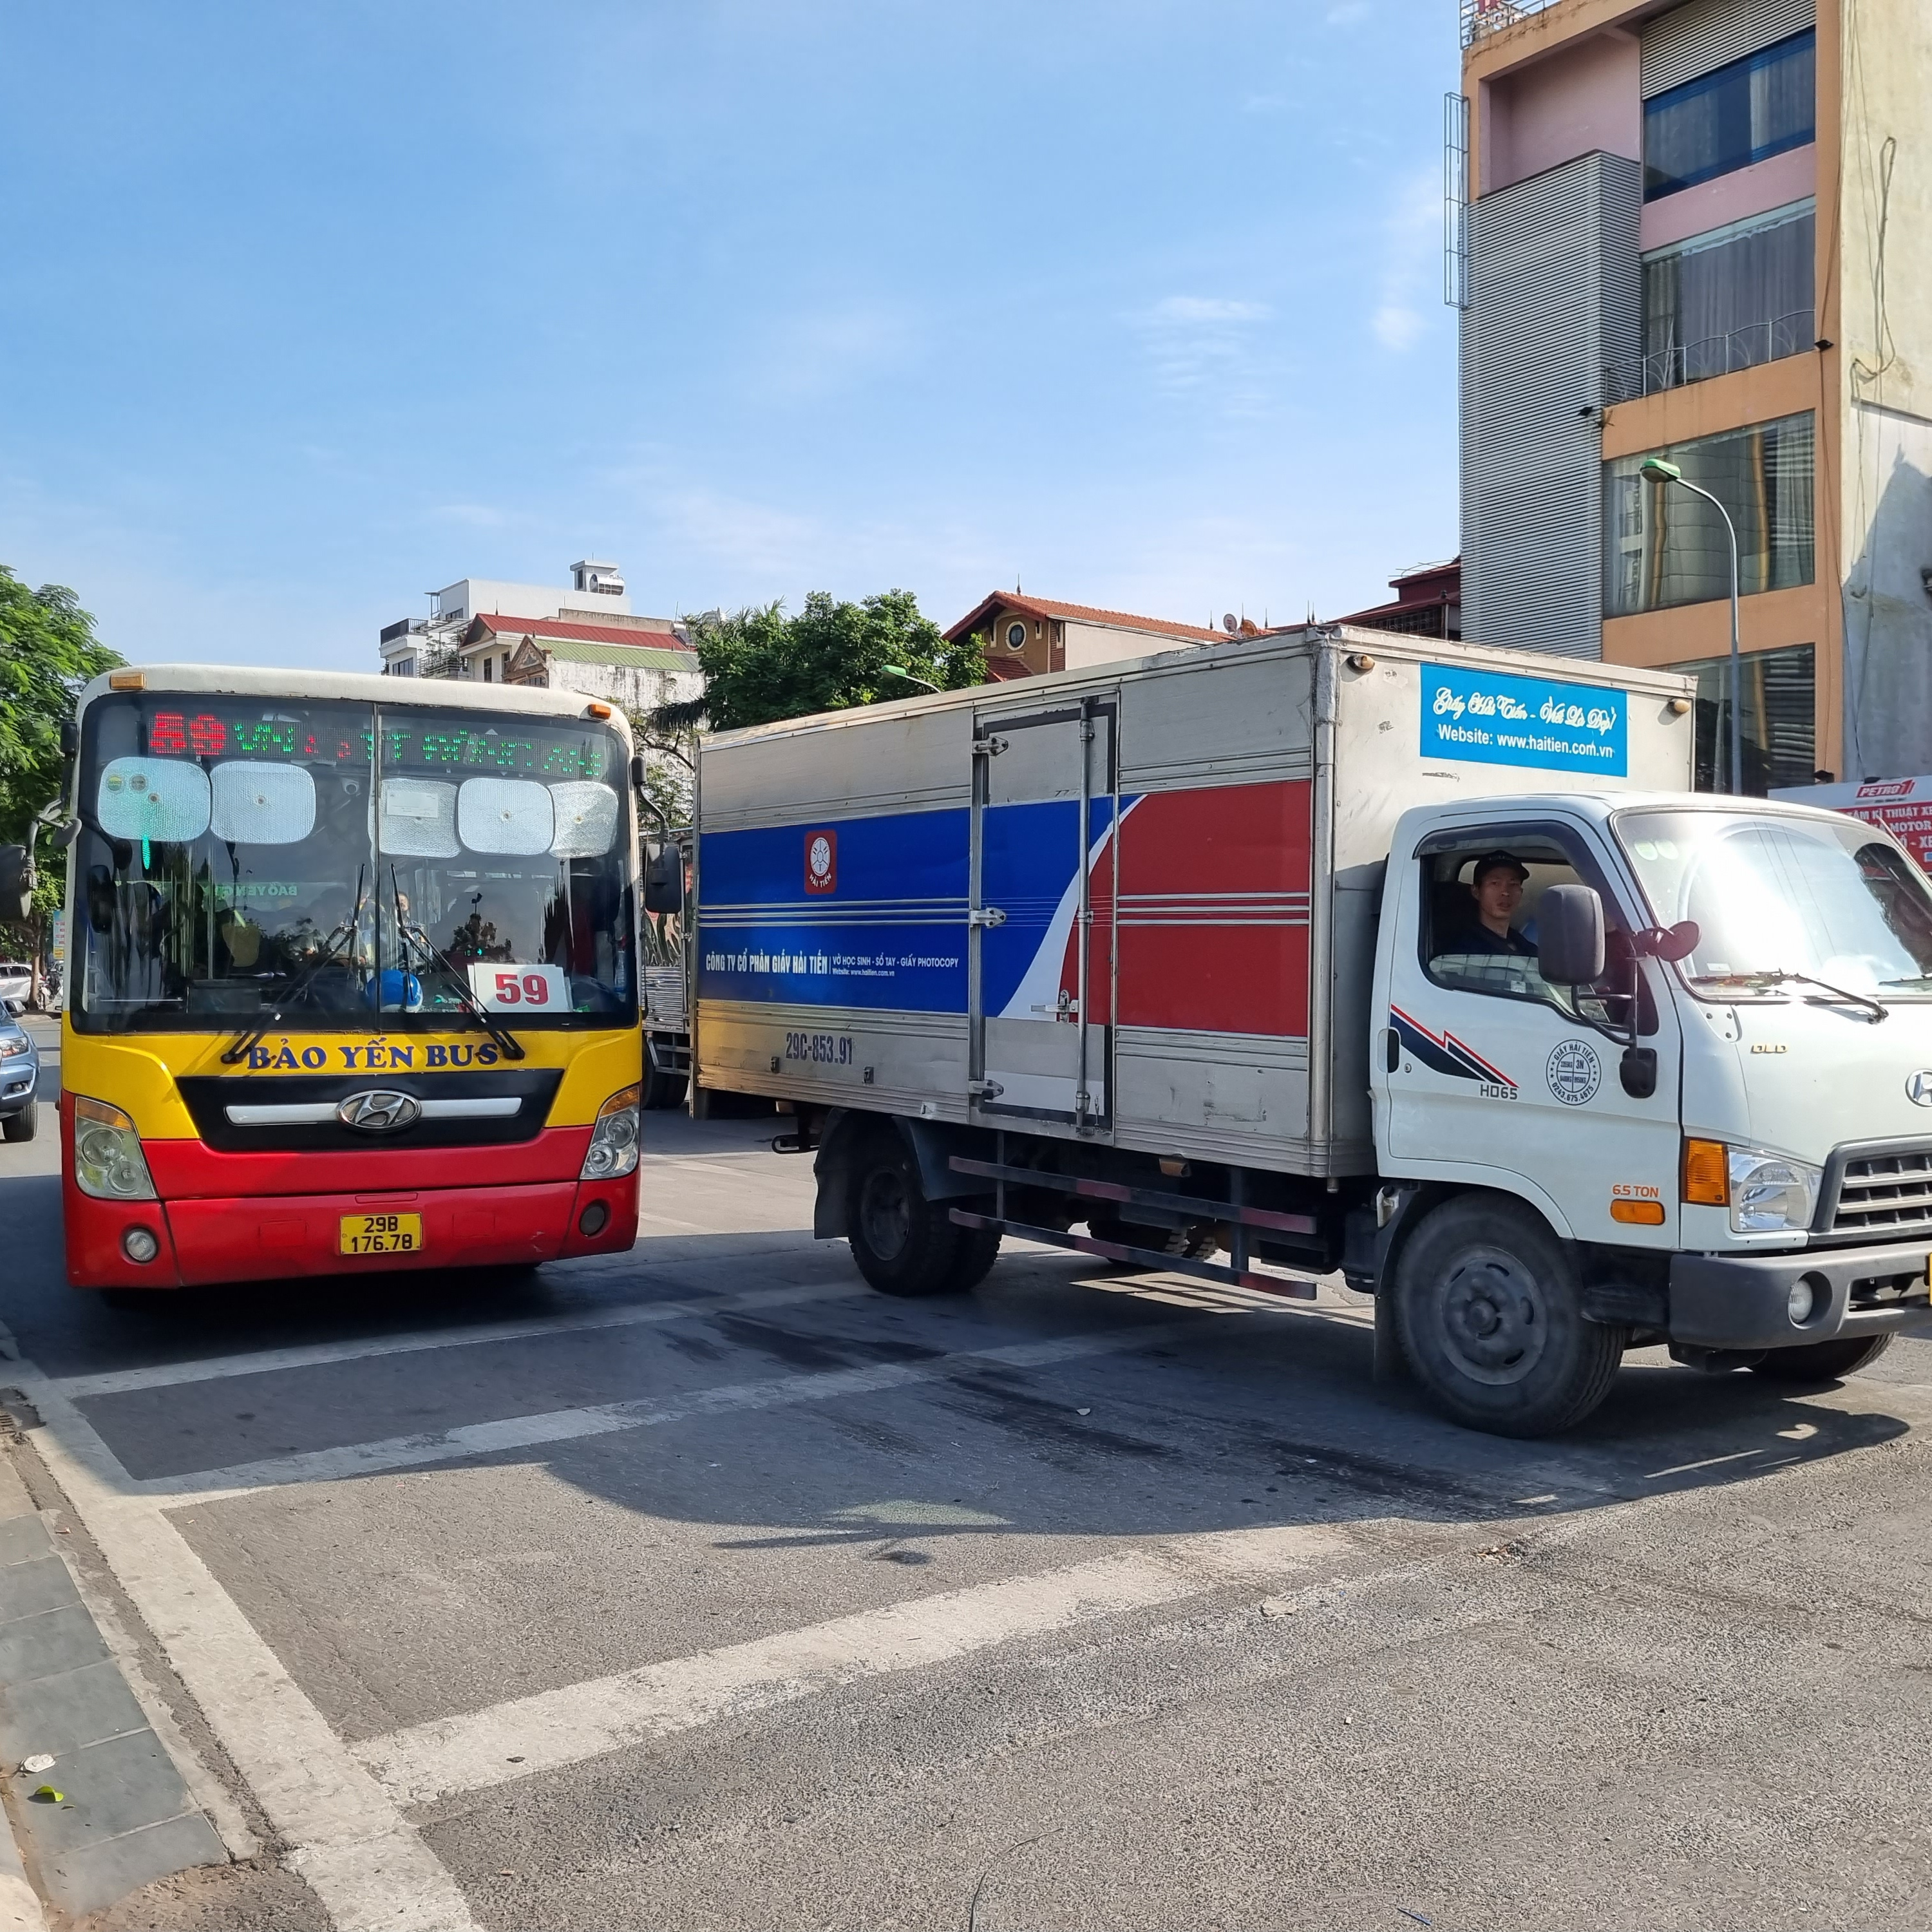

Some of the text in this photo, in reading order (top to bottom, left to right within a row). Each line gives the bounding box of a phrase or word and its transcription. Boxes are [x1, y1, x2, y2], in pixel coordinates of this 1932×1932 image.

[1438, 723, 1613, 758] Website: www.haitien.com.vn
[706, 948, 828, 974] CÔNG TY CỔ PHẦN GIẤY HẢI TIẾN
[842, 956, 856, 967] HỌC
[857, 956, 871, 965] SINH
[886, 956, 896, 966] TAY
[900, 954, 916, 967] GIẤY
[918, 957, 959, 967] PHOTOCOPY
[495, 973, 549, 1006] 59
[247, 1037, 498, 1070] BẢO YẾN BUS
[786, 1032, 853, 1065] 29C-853.91
[1480, 1084, 1518, 1100] HD65
[1633, 1186, 1659, 1198] TON
[364, 1216, 398, 1233] 29B
[352, 1234, 412, 1252] 176.78
